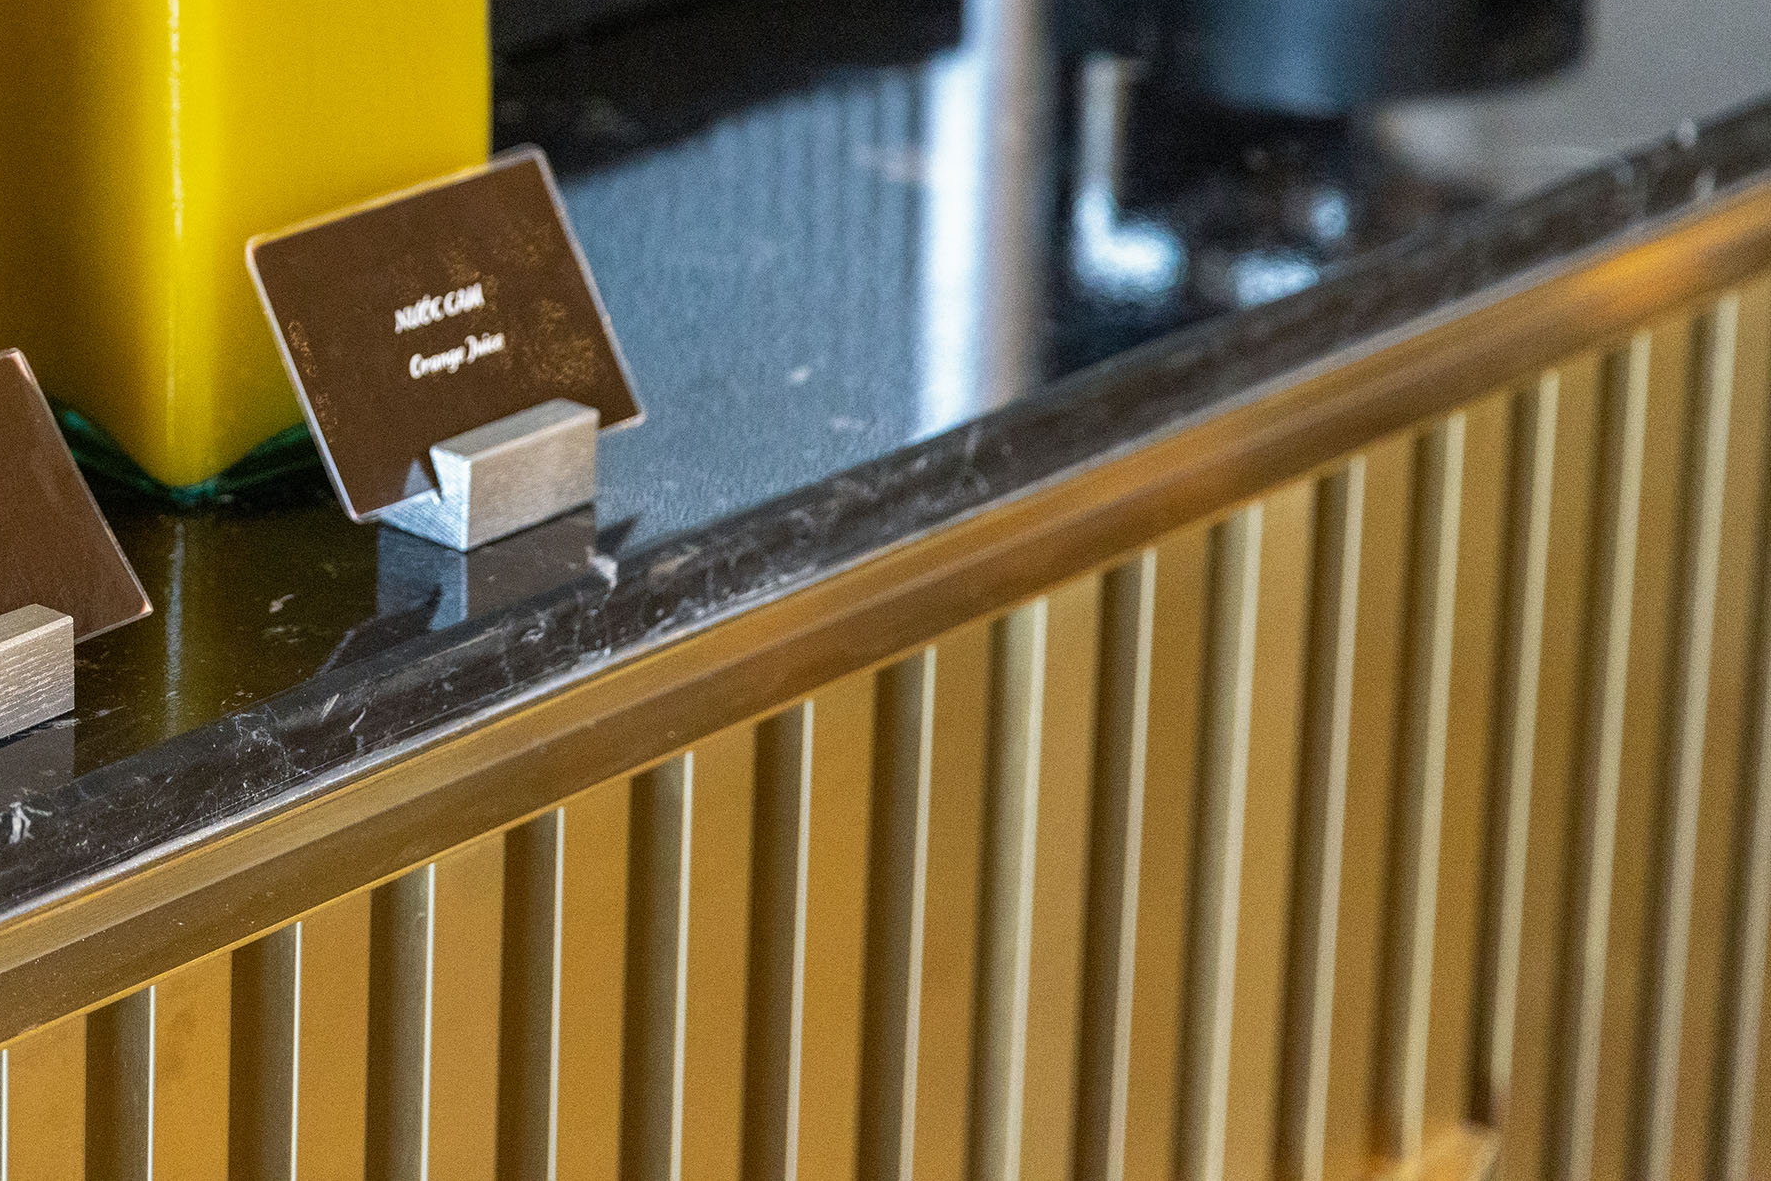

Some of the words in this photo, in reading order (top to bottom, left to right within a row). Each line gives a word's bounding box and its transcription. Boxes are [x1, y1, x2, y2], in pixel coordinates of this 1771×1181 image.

[443, 282, 485, 317] CAM
[409, 345, 466, 379] Orange
[464, 332, 506, 365] Juice
